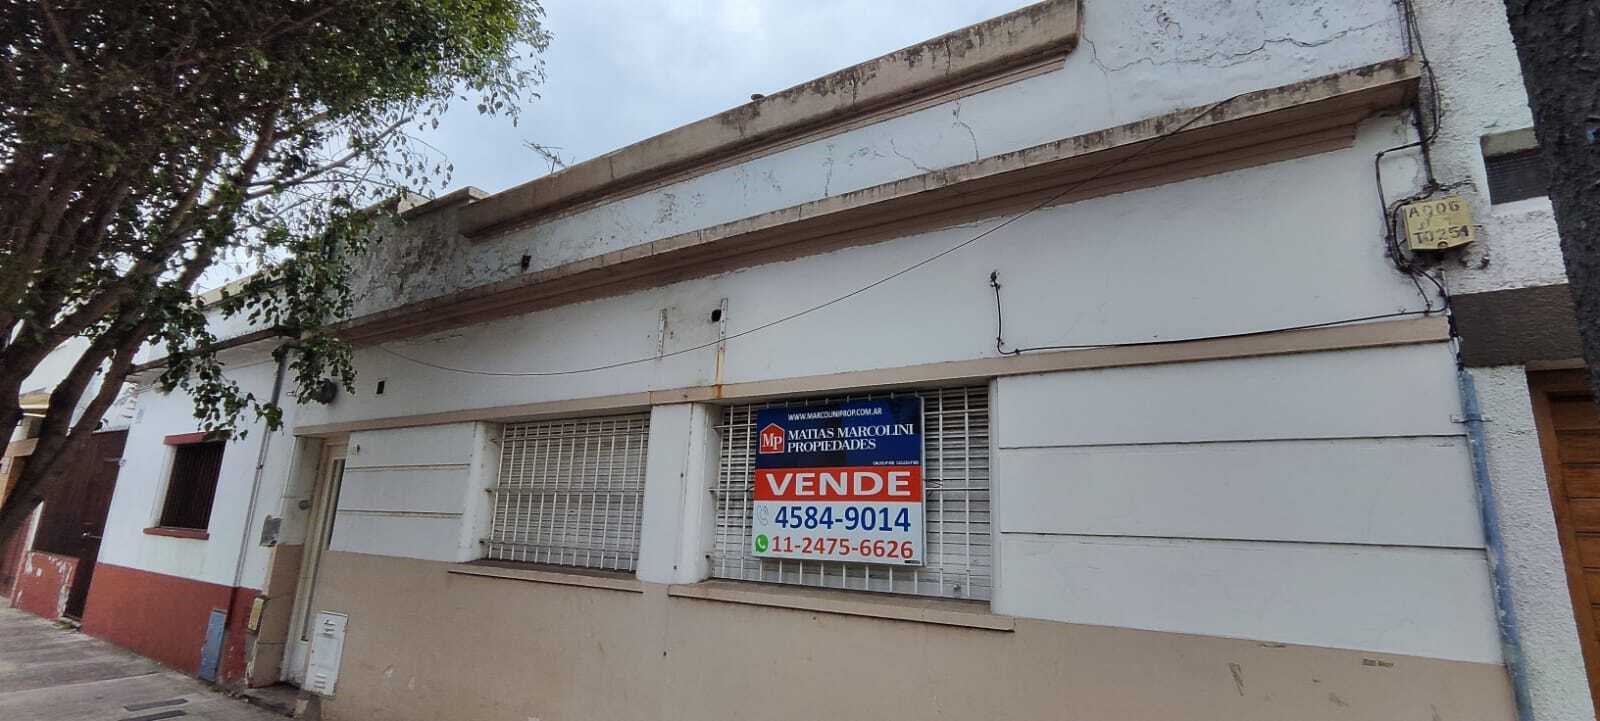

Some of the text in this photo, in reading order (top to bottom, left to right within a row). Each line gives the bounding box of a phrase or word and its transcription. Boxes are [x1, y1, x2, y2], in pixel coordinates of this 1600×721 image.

[788, 423, 914, 440] MATIAS MARCOLINI
[788, 438, 876, 453] PROPIEDADES
[766, 472, 911, 496] VENDE
[775, 506, 911, 532] 4584-9014
[772, 535, 913, 559] 11-2475-6626
